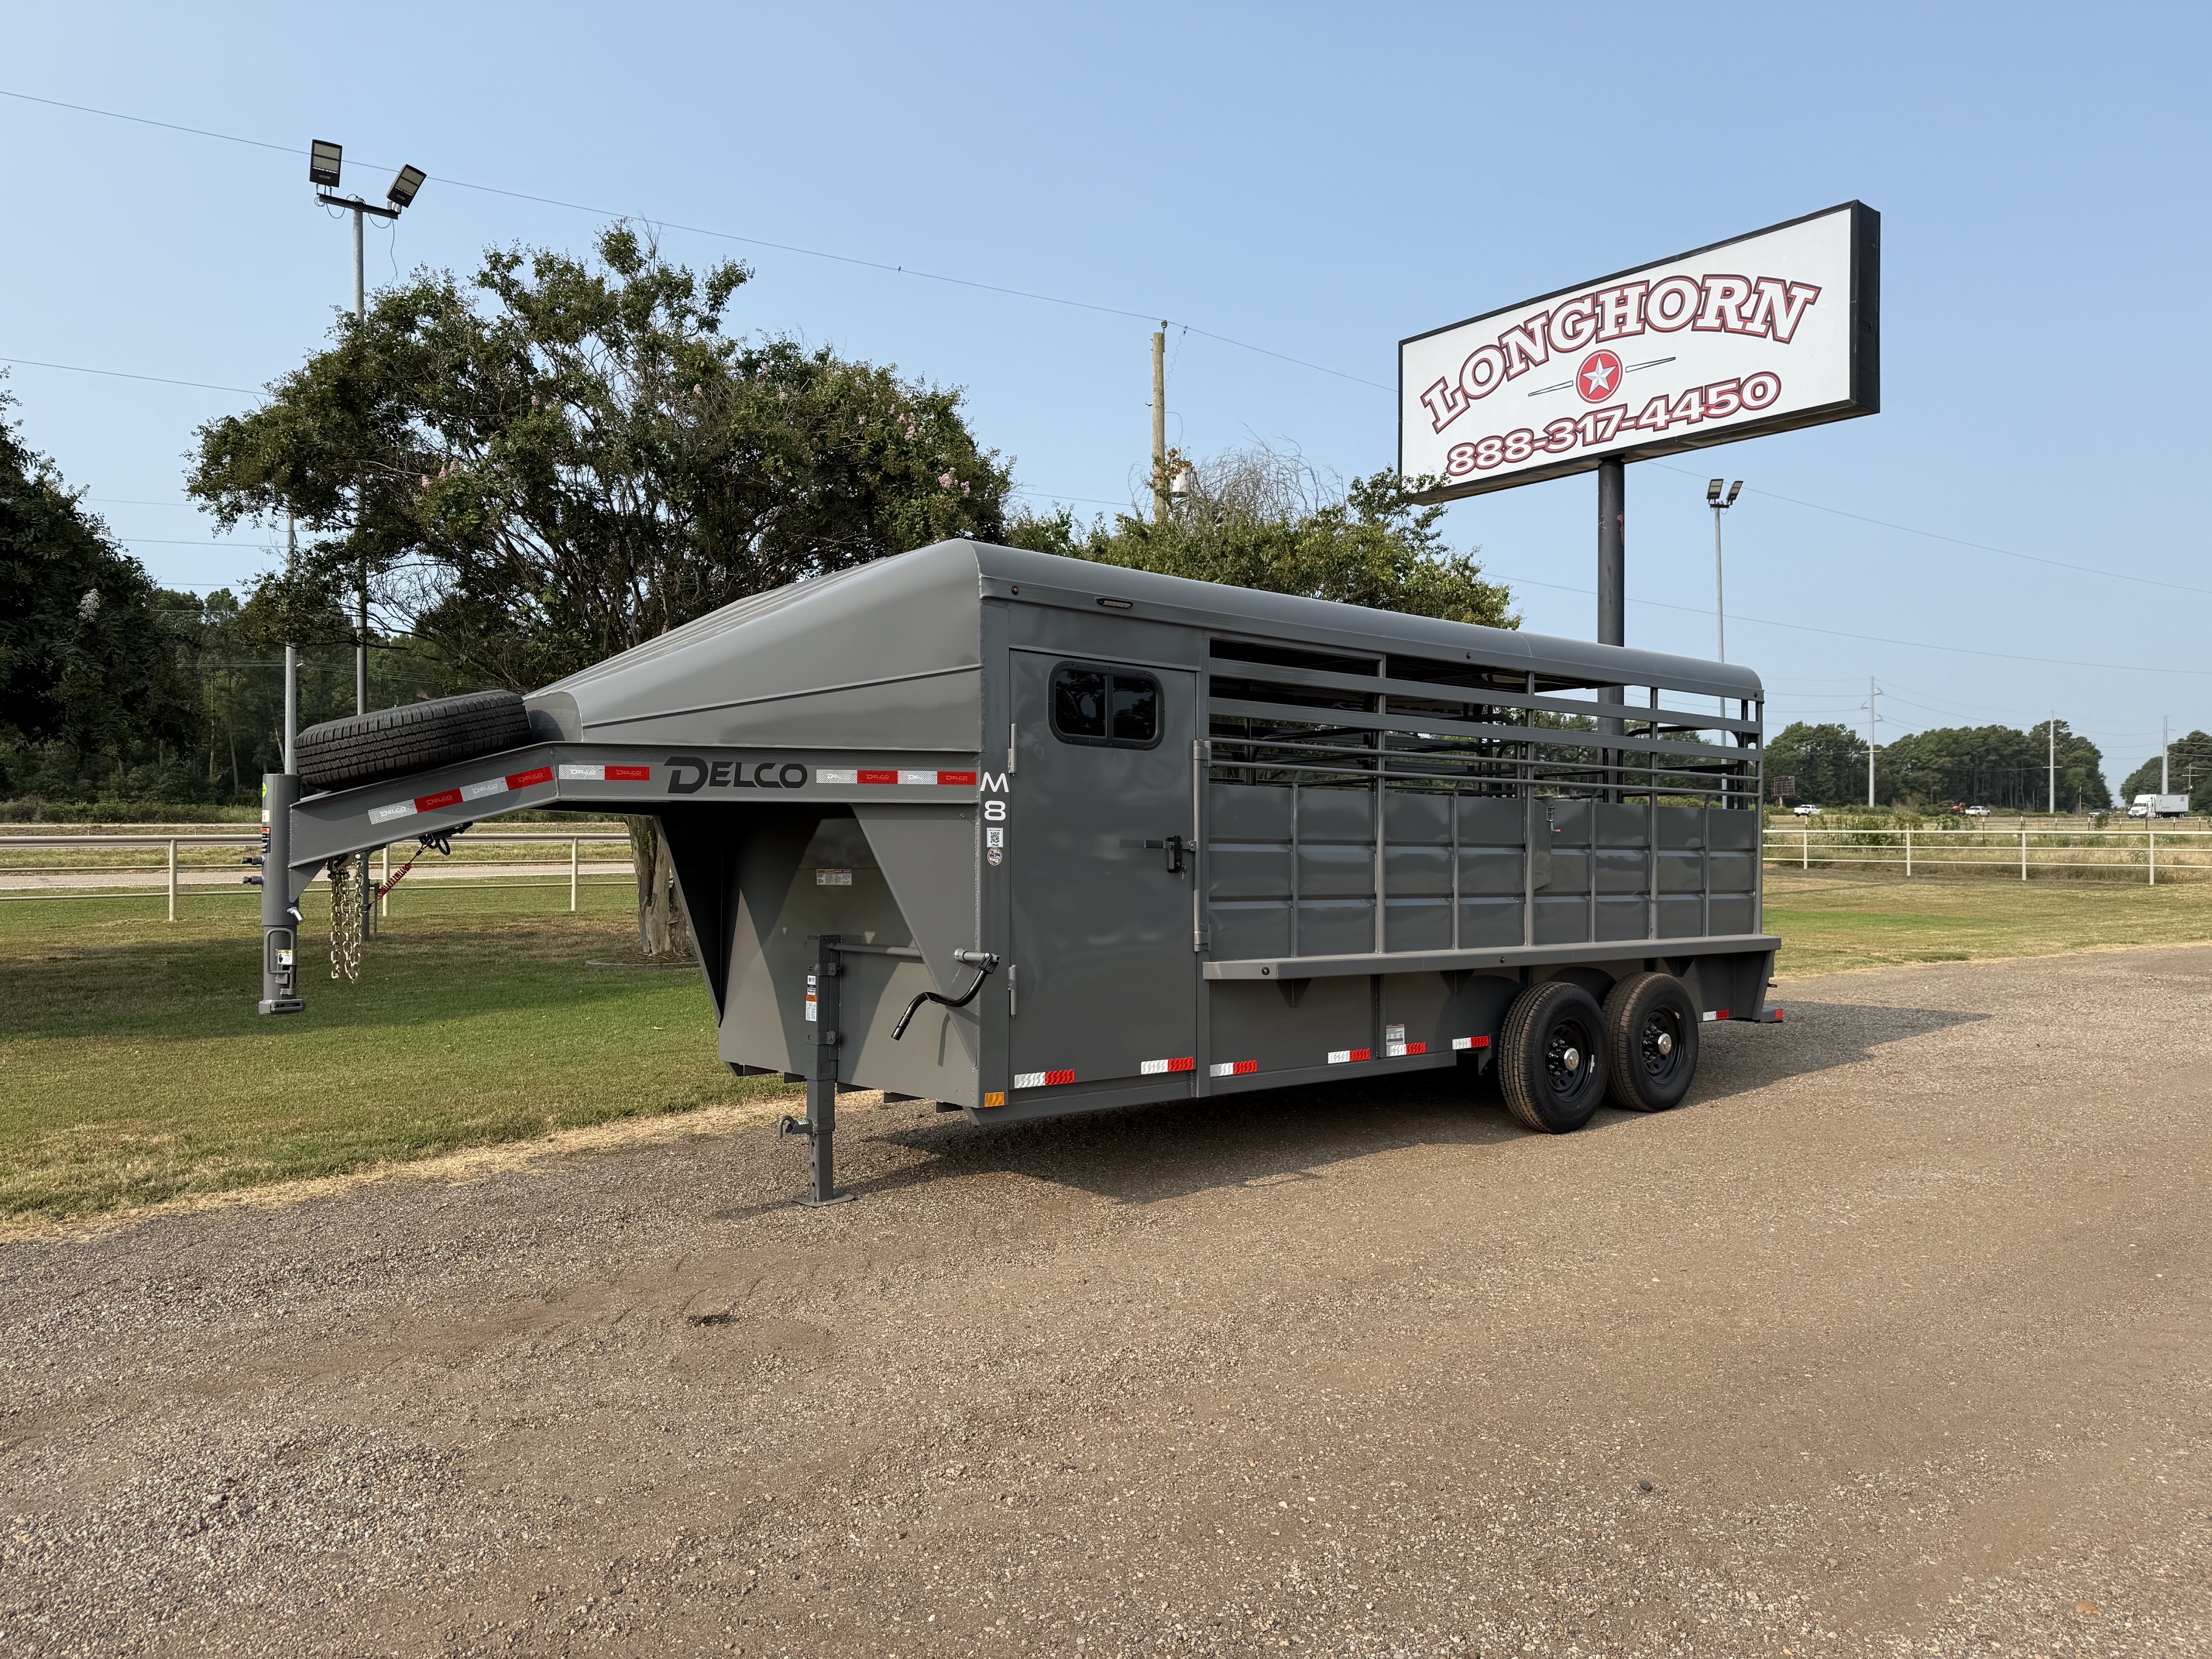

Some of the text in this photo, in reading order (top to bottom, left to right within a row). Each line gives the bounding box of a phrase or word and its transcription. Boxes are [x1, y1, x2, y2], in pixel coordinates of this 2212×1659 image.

[1421, 273, 1822, 434] LONGHORN
[1447, 372, 1782, 476] 888-317-4450
[379, 773, 543, 817] DELCO DELCO DELCO DELCO
[664, 756, 808, 794] DELCO
